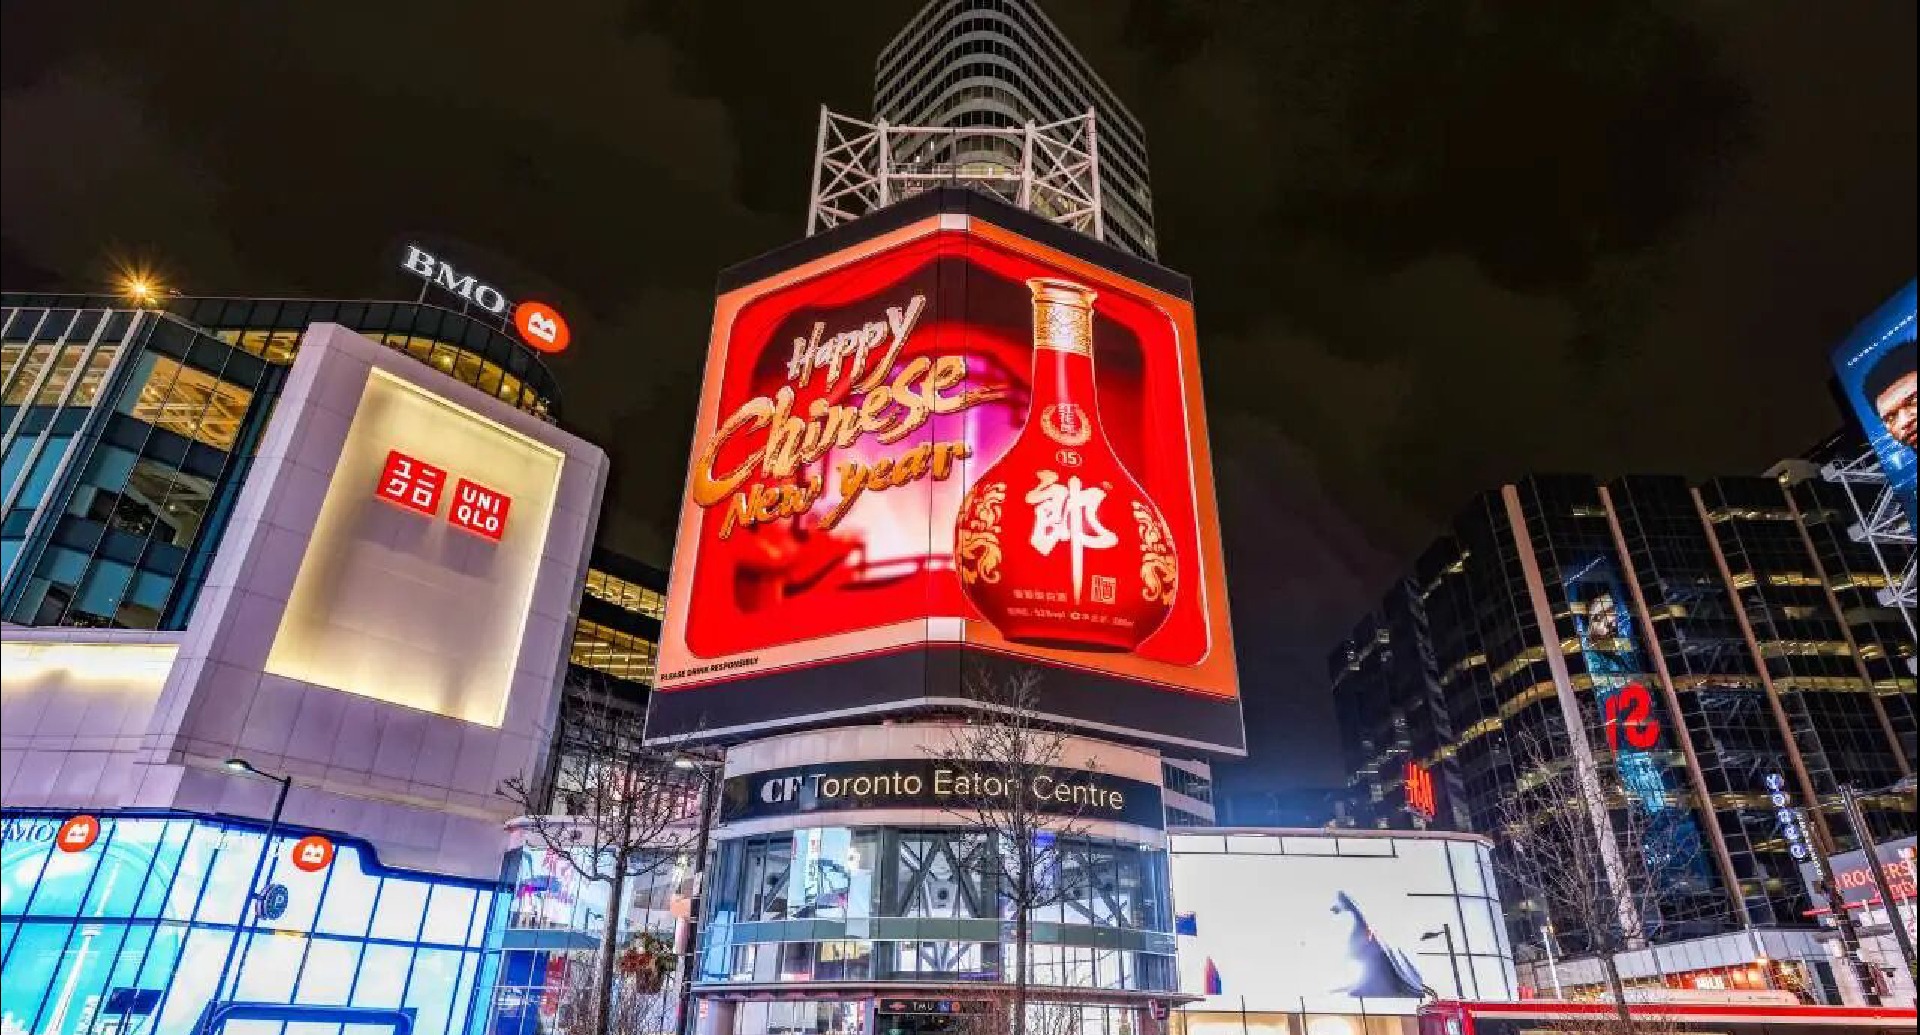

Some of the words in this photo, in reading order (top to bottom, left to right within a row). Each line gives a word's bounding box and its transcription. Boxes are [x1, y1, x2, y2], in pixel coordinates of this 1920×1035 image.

[403, 245, 505, 313] BMO
[785, 294, 925, 393] Happy
[693, 356, 1008, 506] Chinese
[1063, 451, 1077, 465] 15
[461, 487, 500, 513] UNI
[718, 475, 824, 539] New
[817, 442, 972, 530] year
[457, 505, 499, 531] QLO
[660, 669, 686, 681] PLEASE
[687, 665, 709, 677] DRINK
[711, 656, 759, 671] RESPONSIBLY
[760, 776, 803, 804] CF
[808, 770, 923, 798] Toronto
[1032, 775, 1124, 810] Centre
[1, 821, 56, 842] MO
[913, 1001, 933, 1011] TMU
